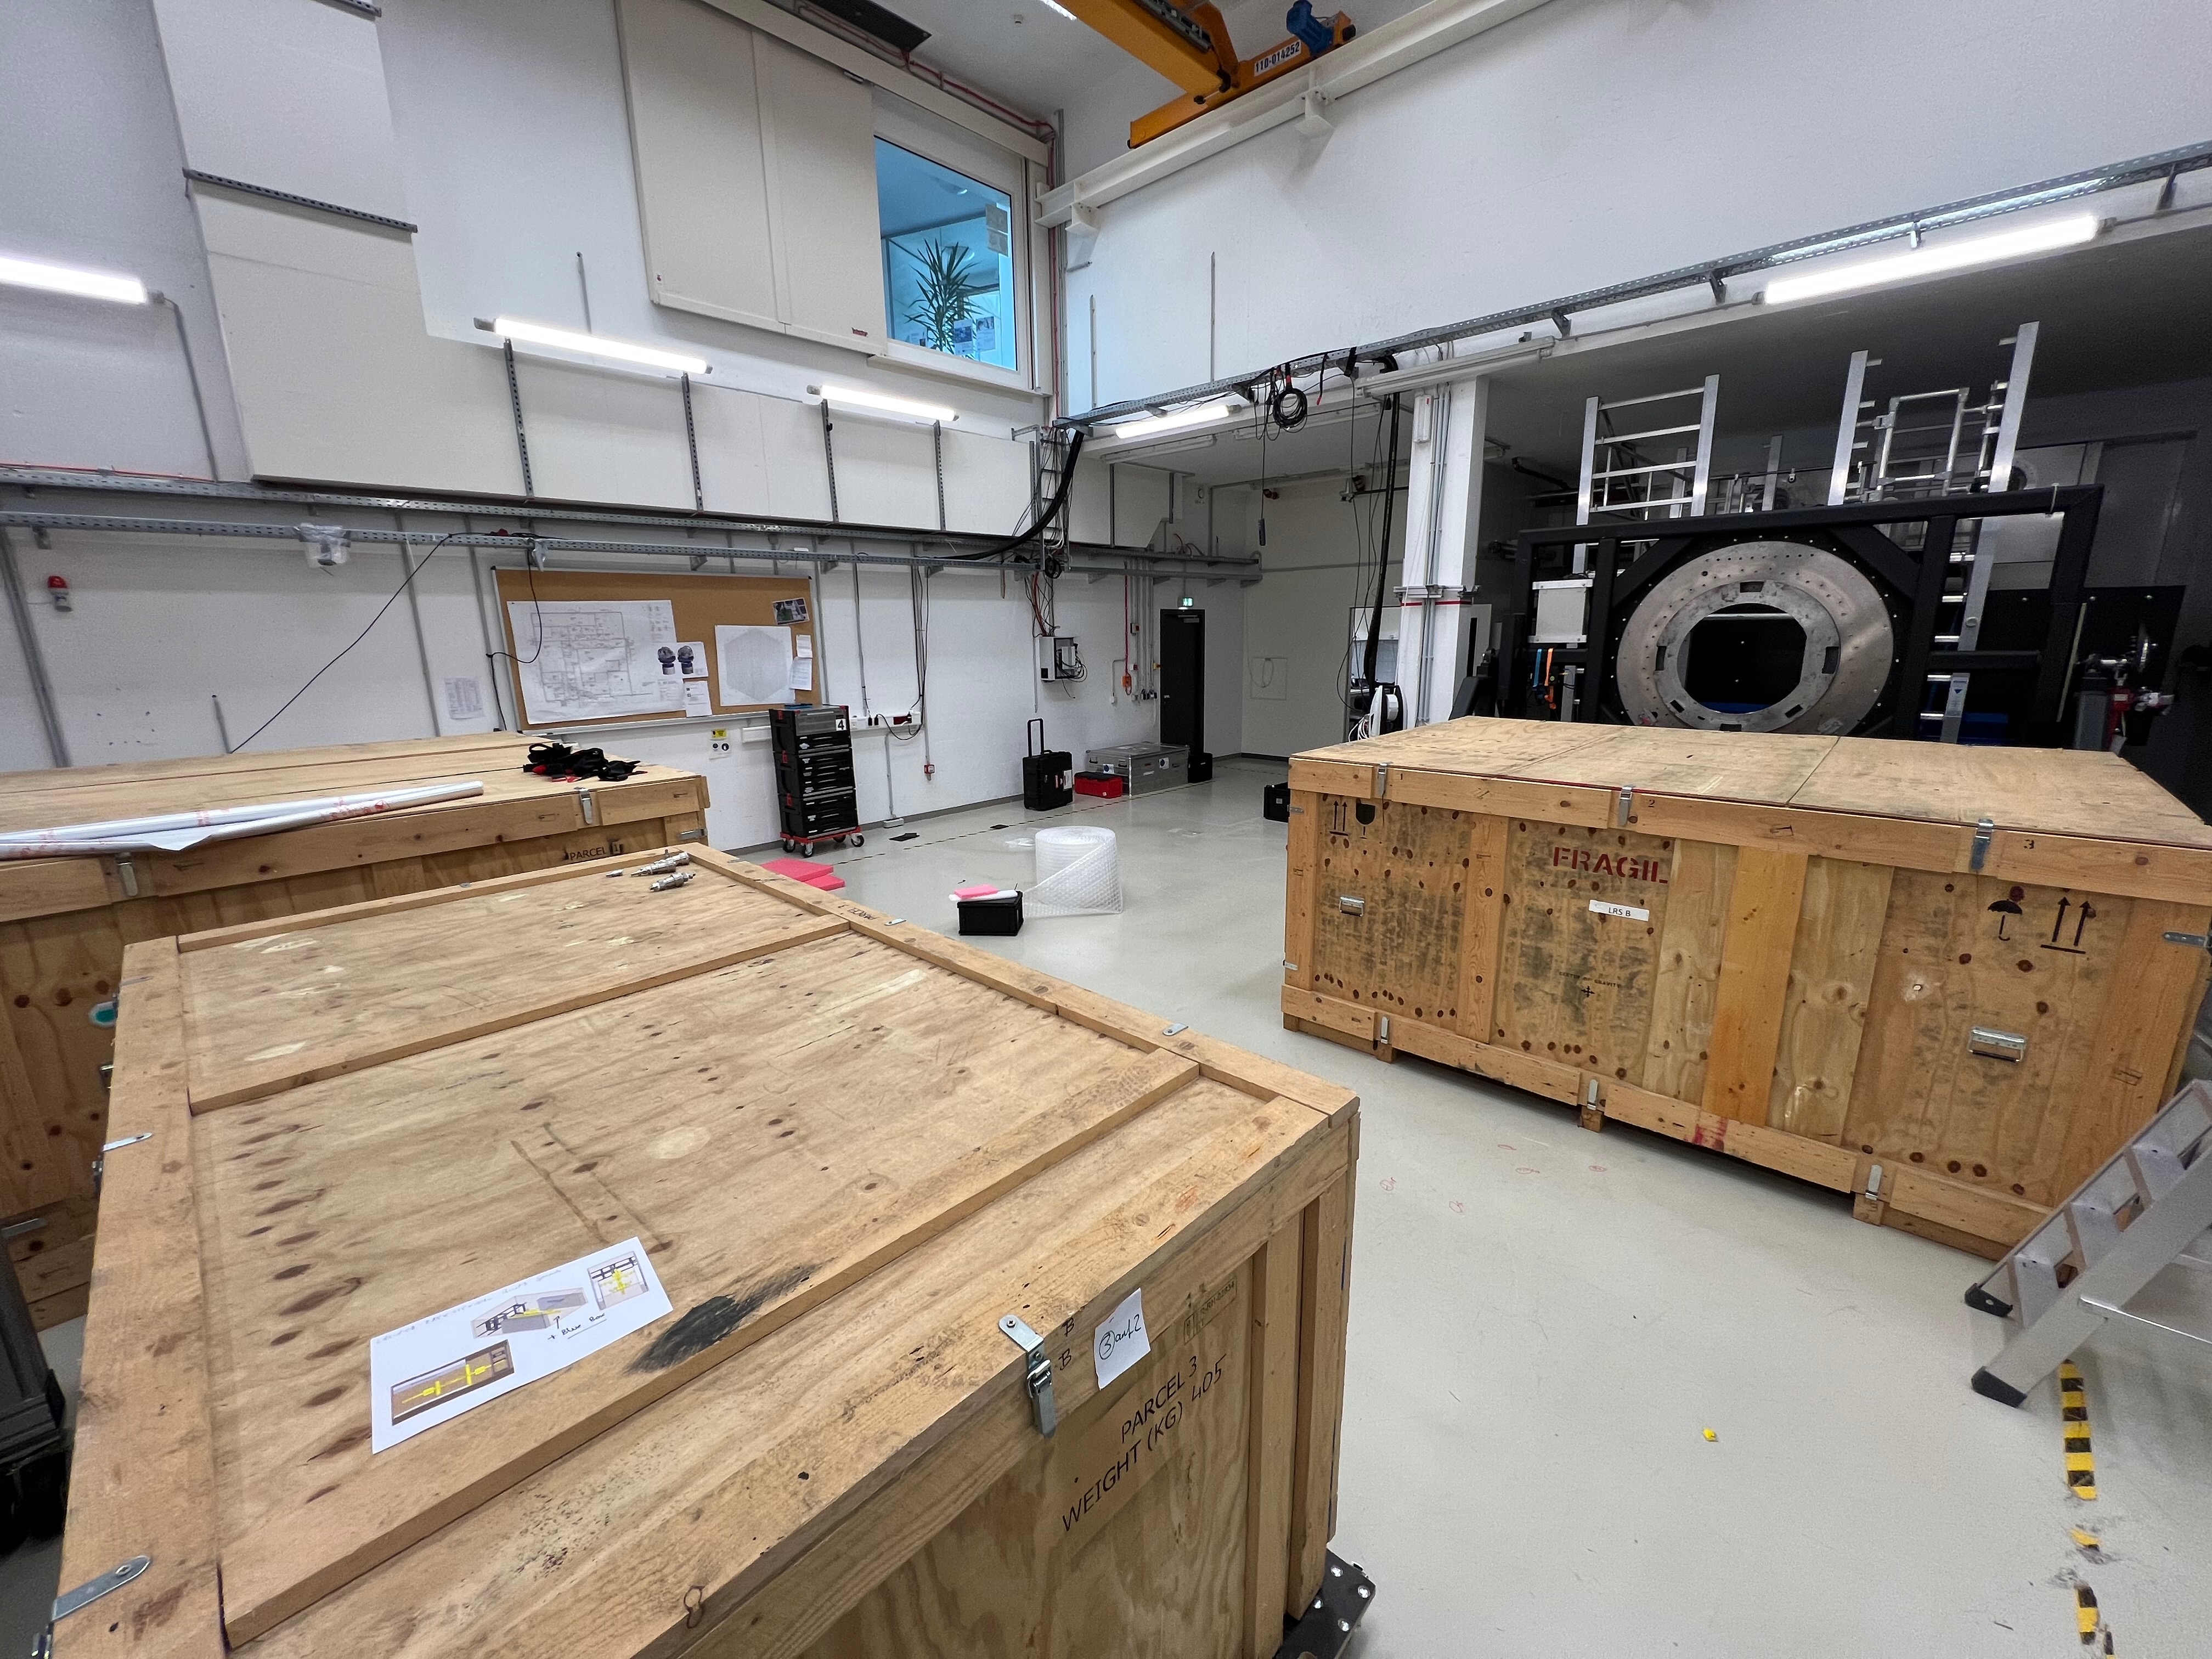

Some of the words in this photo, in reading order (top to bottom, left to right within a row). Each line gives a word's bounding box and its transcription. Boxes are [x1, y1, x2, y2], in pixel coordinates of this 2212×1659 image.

[837, 719, 845, 731] 4
[1647, 799, 1656, 808] 2
[2023, 839, 2035, 850] 3
[569, 846, 607, 861] PARCEL
[1607, 906, 1623, 916] LRS
[1062, 1317, 1075, 1337] B
[1133, 1313, 1142, 1332] 2
[1058, 1348, 1071, 1370] B
[1121, 1372, 1185, 1444] PARCEL
[1189, 1355, 1197, 1378] 3
[1062, 1438, 1142, 1532] WEIGHT
[1147, 1401, 1183, 1451] (KG)
[1191, 1353, 1227, 1402] 405
